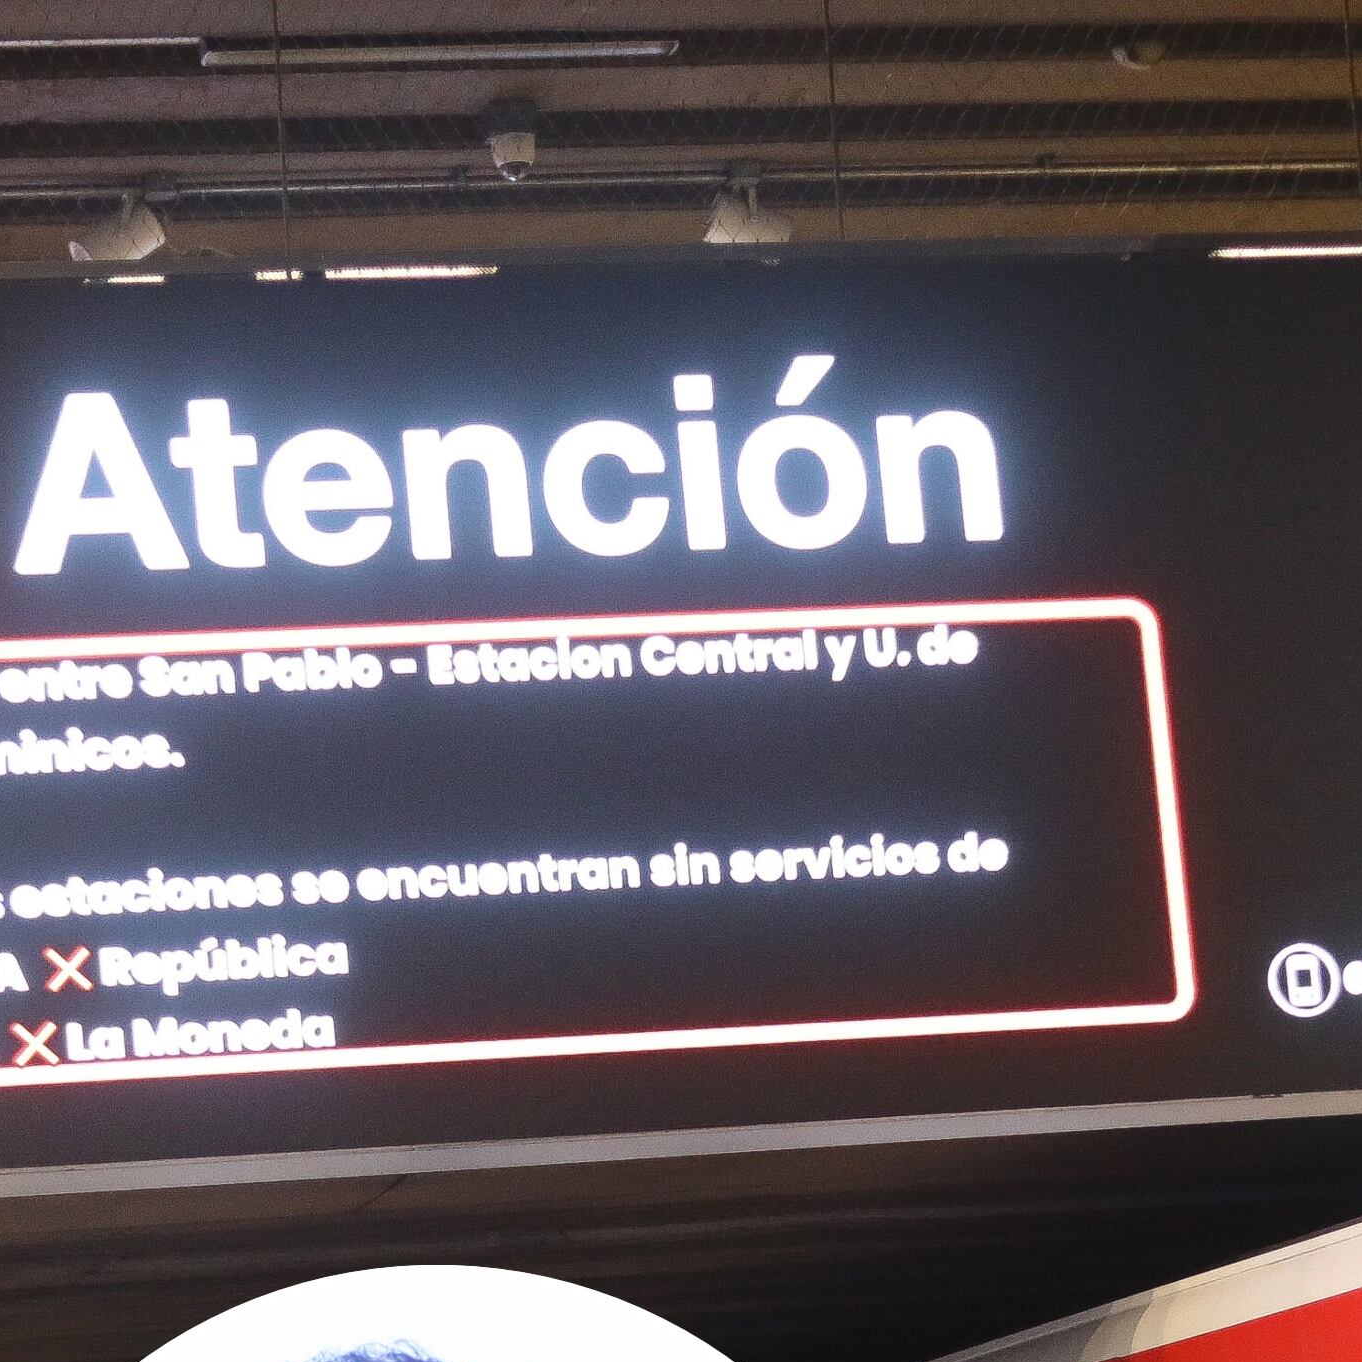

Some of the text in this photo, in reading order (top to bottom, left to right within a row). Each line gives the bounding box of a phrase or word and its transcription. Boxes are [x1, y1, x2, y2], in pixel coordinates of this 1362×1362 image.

[13, 354, 1005, 576] Atención
[138, 655, 236, 698] San
[241, 646, 383, 693] Pablo
[639, 628, 819, 677] Central
[823, 635, 857, 682] y
[862, 627, 912, 668] U.
[916, 623, 979, 666] de
[9, 867, 284, 919] estaciones
[291, 869, 350, 905] se
[356, 853, 641, 902] encuentran
[649, 842, 721, 887] sin
[729, 833, 941, 883] servicios
[947, 831, 1009, 873] de
[98, 933, 349, 997] República
[65, 1022, 126, 1062] La
[131, 1008, 336, 1059] Moneda
